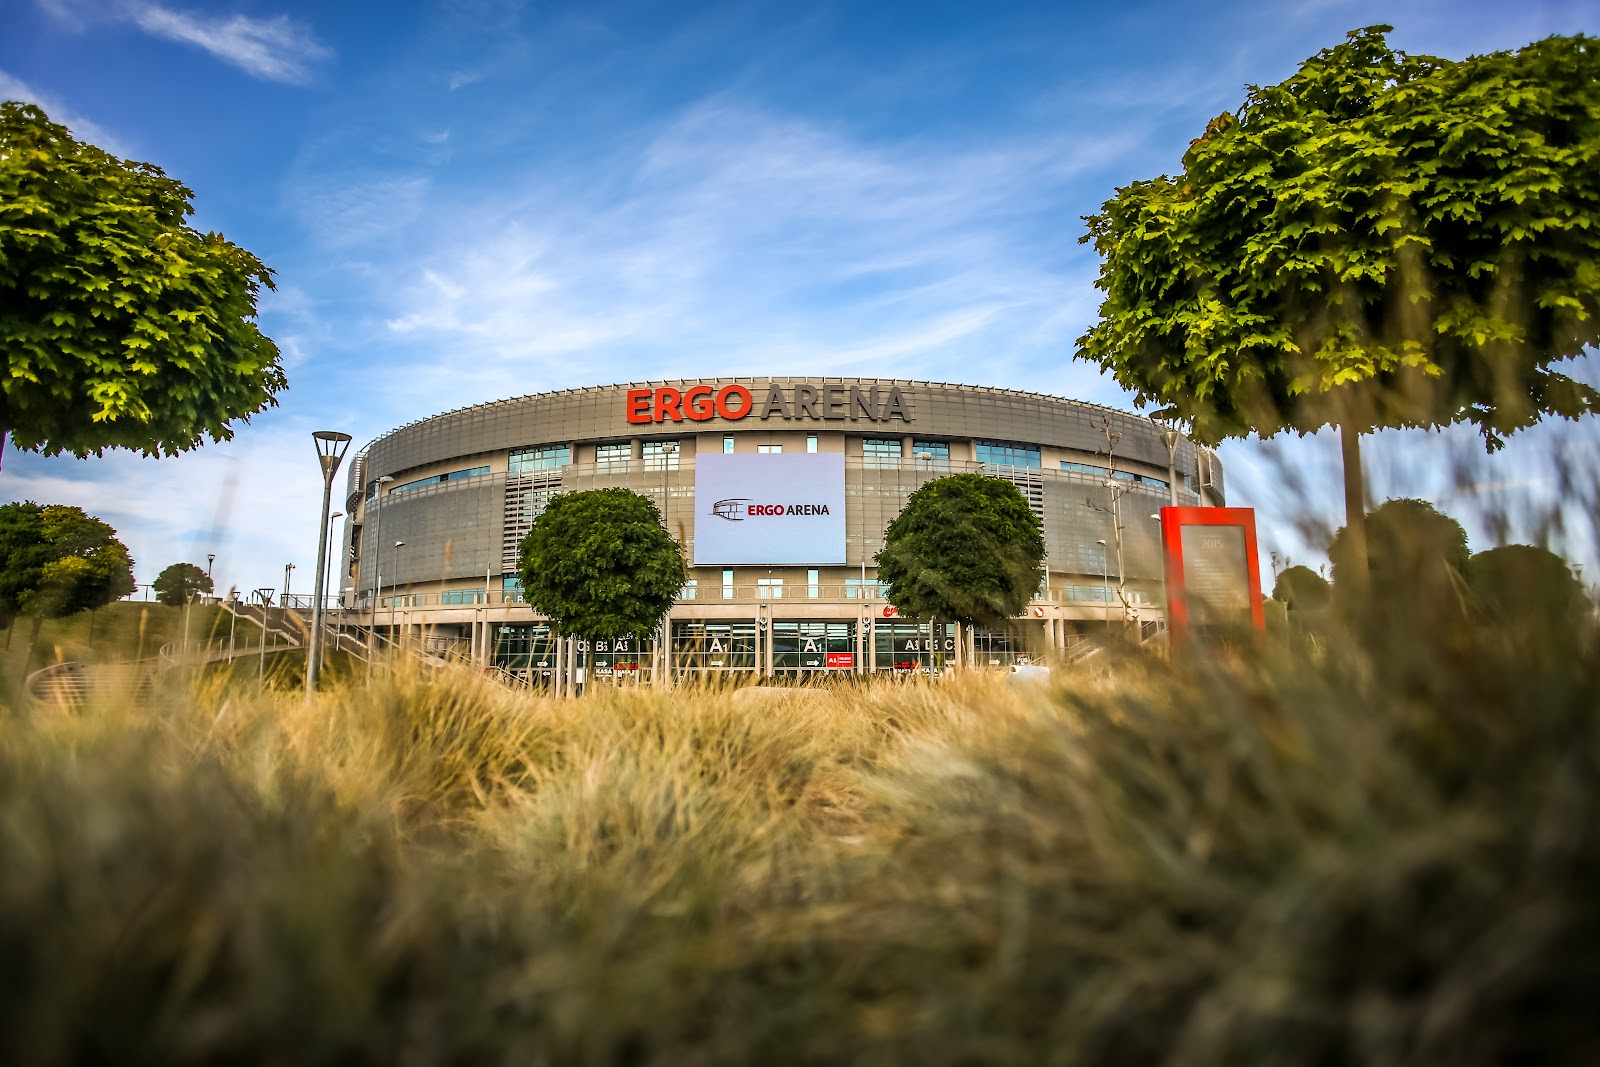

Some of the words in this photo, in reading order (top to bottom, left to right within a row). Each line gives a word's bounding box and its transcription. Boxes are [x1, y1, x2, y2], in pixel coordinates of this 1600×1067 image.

[626, 384, 753, 424] ERGO
[760, 384, 912, 422] ARENA
[747, 504, 784, 516] ERGO
[786, 504, 830, 516] ARENA
[1201, 539, 1224, 549] 2015
[709, 638, 727, 652] A1
[804, 638, 822, 652] A1
